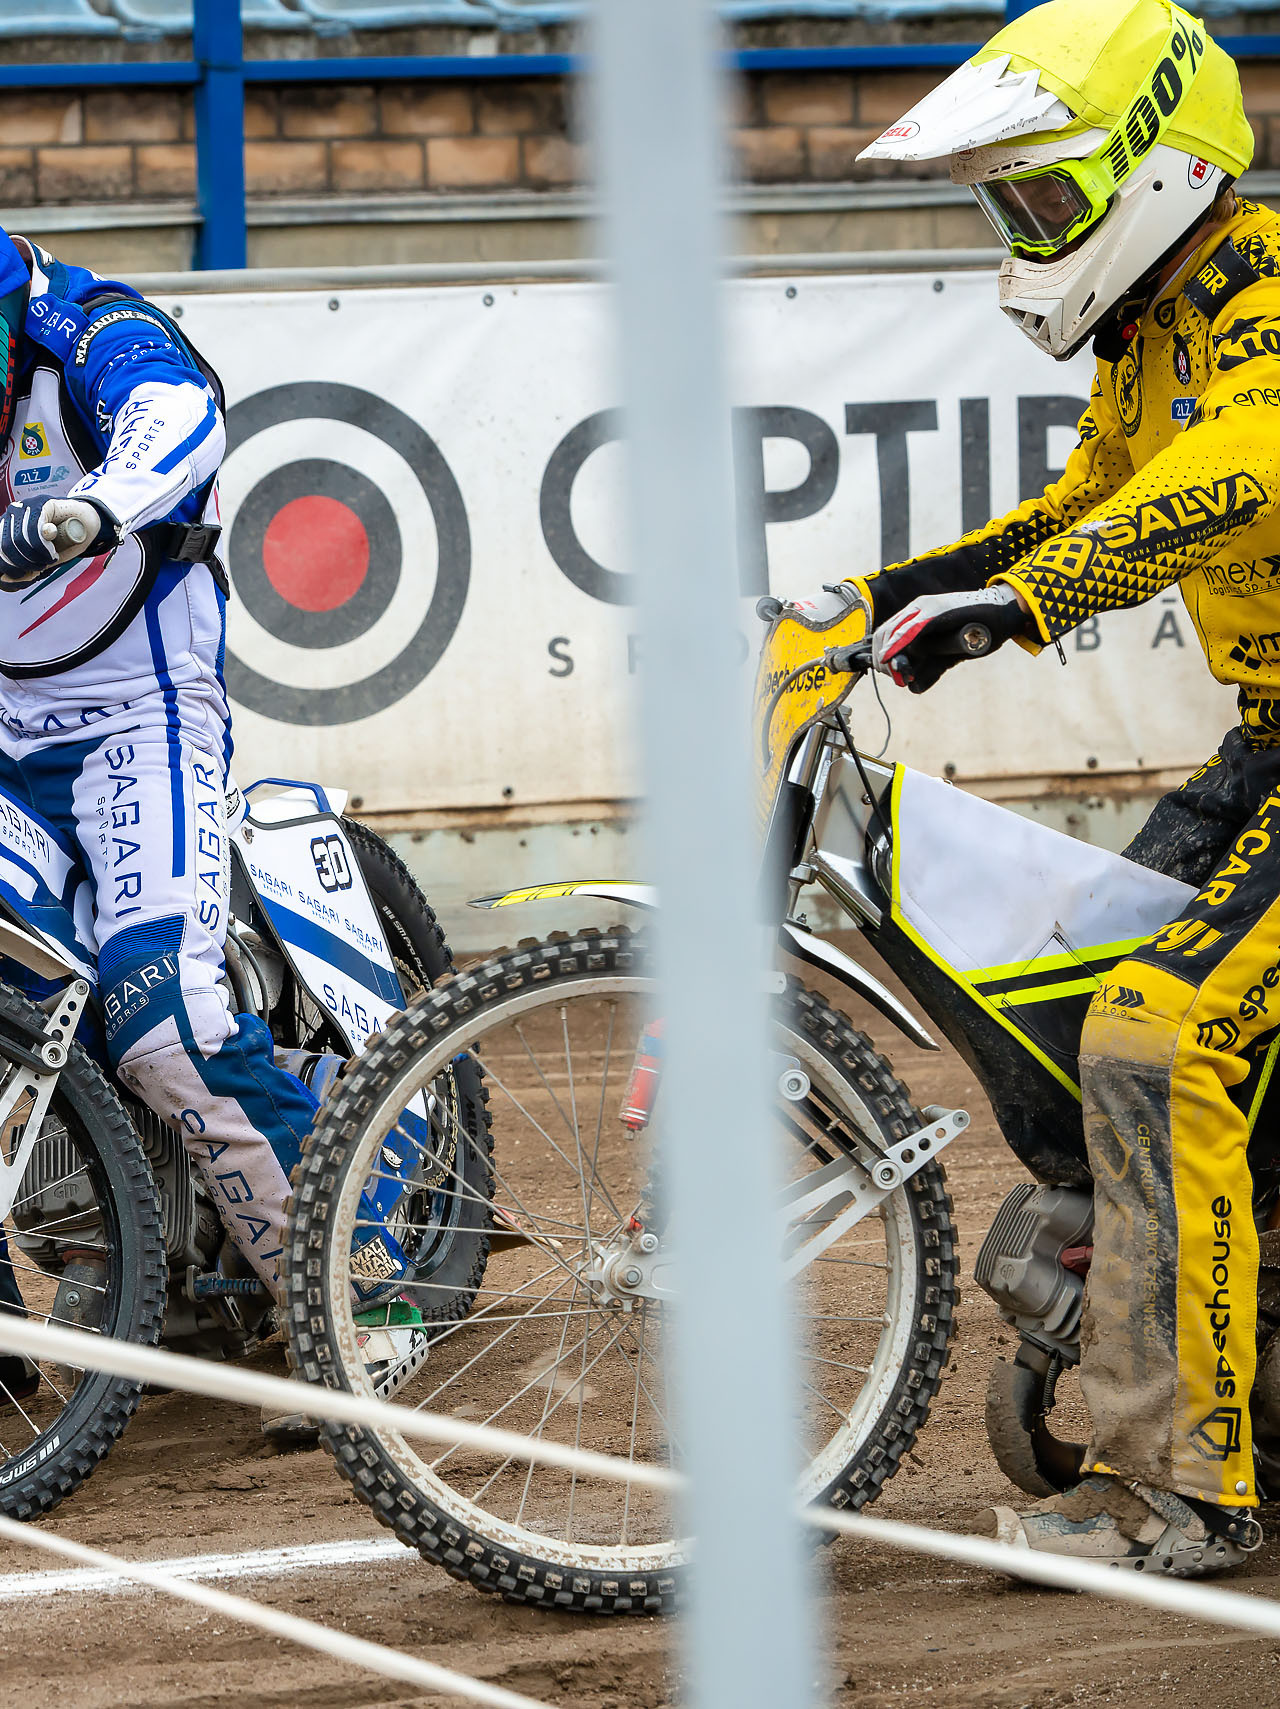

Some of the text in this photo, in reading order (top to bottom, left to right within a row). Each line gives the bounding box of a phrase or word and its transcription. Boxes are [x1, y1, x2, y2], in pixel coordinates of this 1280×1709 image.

[1099, 17, 1204, 185] 100%
[881, 126, 913, 139] BELL
[125, 418, 165, 470] SPORTS
[20, 469, 42, 484] 2LŻ
[1098, 474, 1266, 549] SALVA
[1127, 547, 1151, 560] OKNA
[1156, 535, 1184, 550] DRZWI
[2, 825, 37, 860] SPORTS
[104, 744, 142, 919] SAGARI
[310, 833, 353, 894] 30
[250, 863, 383, 953] SAGARI SAGARI SAGARI
[104, 958, 175, 1024] GARI
[106, 996, 146, 1038] SPORTS
[323, 983, 384, 1035] SAGA
[171, 1108, 284, 1282] SAGA
[1205, 1195, 1235, 1399] spechouse
